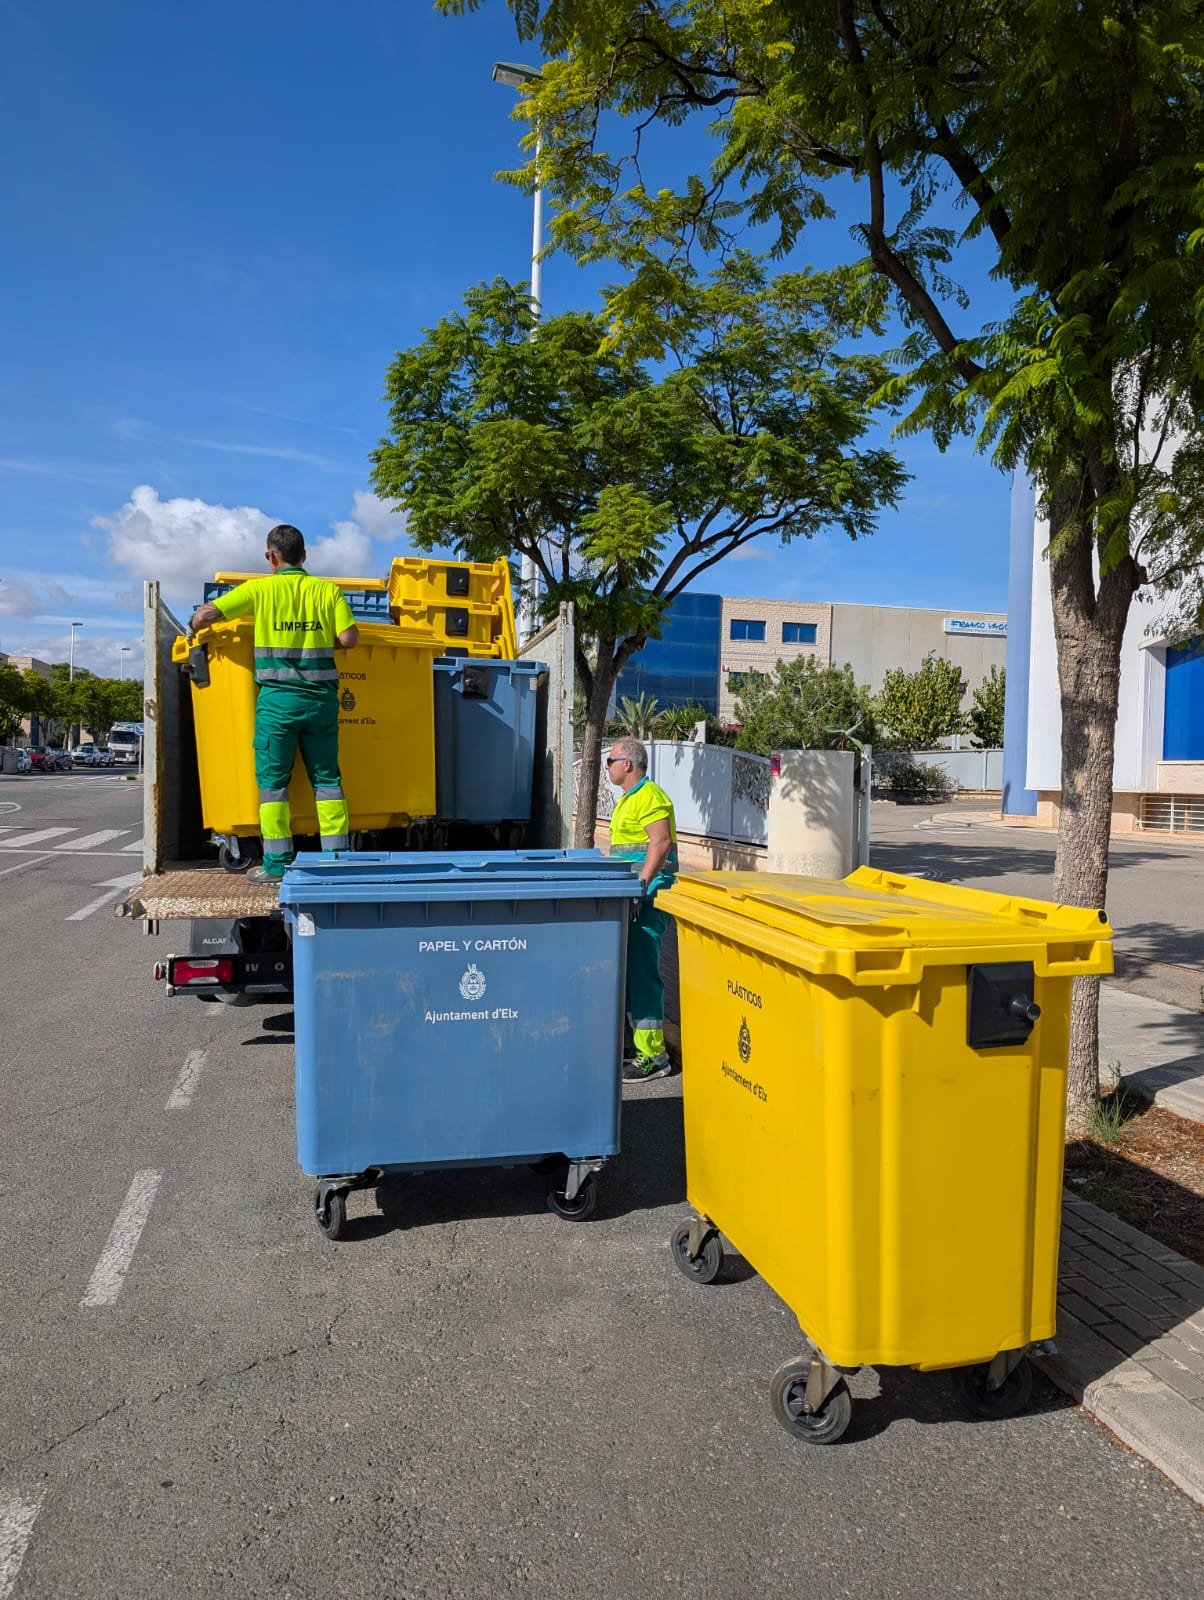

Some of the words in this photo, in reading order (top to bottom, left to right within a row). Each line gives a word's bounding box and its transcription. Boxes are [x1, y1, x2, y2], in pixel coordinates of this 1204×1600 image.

[273, 620, 324, 632] LIMPEZA
[339, 672, 367, 681] STICOS
[339, 718, 360, 726] ament
[418, 941, 460, 953] PAPEL
[462, 940, 472, 952] Y
[474, 937, 528, 952] CARTÓN
[727, 979, 763, 1010] PLÁSTICOS
[424, 1010, 490, 1025] Ajuntament
[491, 1008, 519, 1020] d'Elx
[721, 1060, 753, 1093] Ajuntament
[752, 1083, 768, 1104] d'Elx
